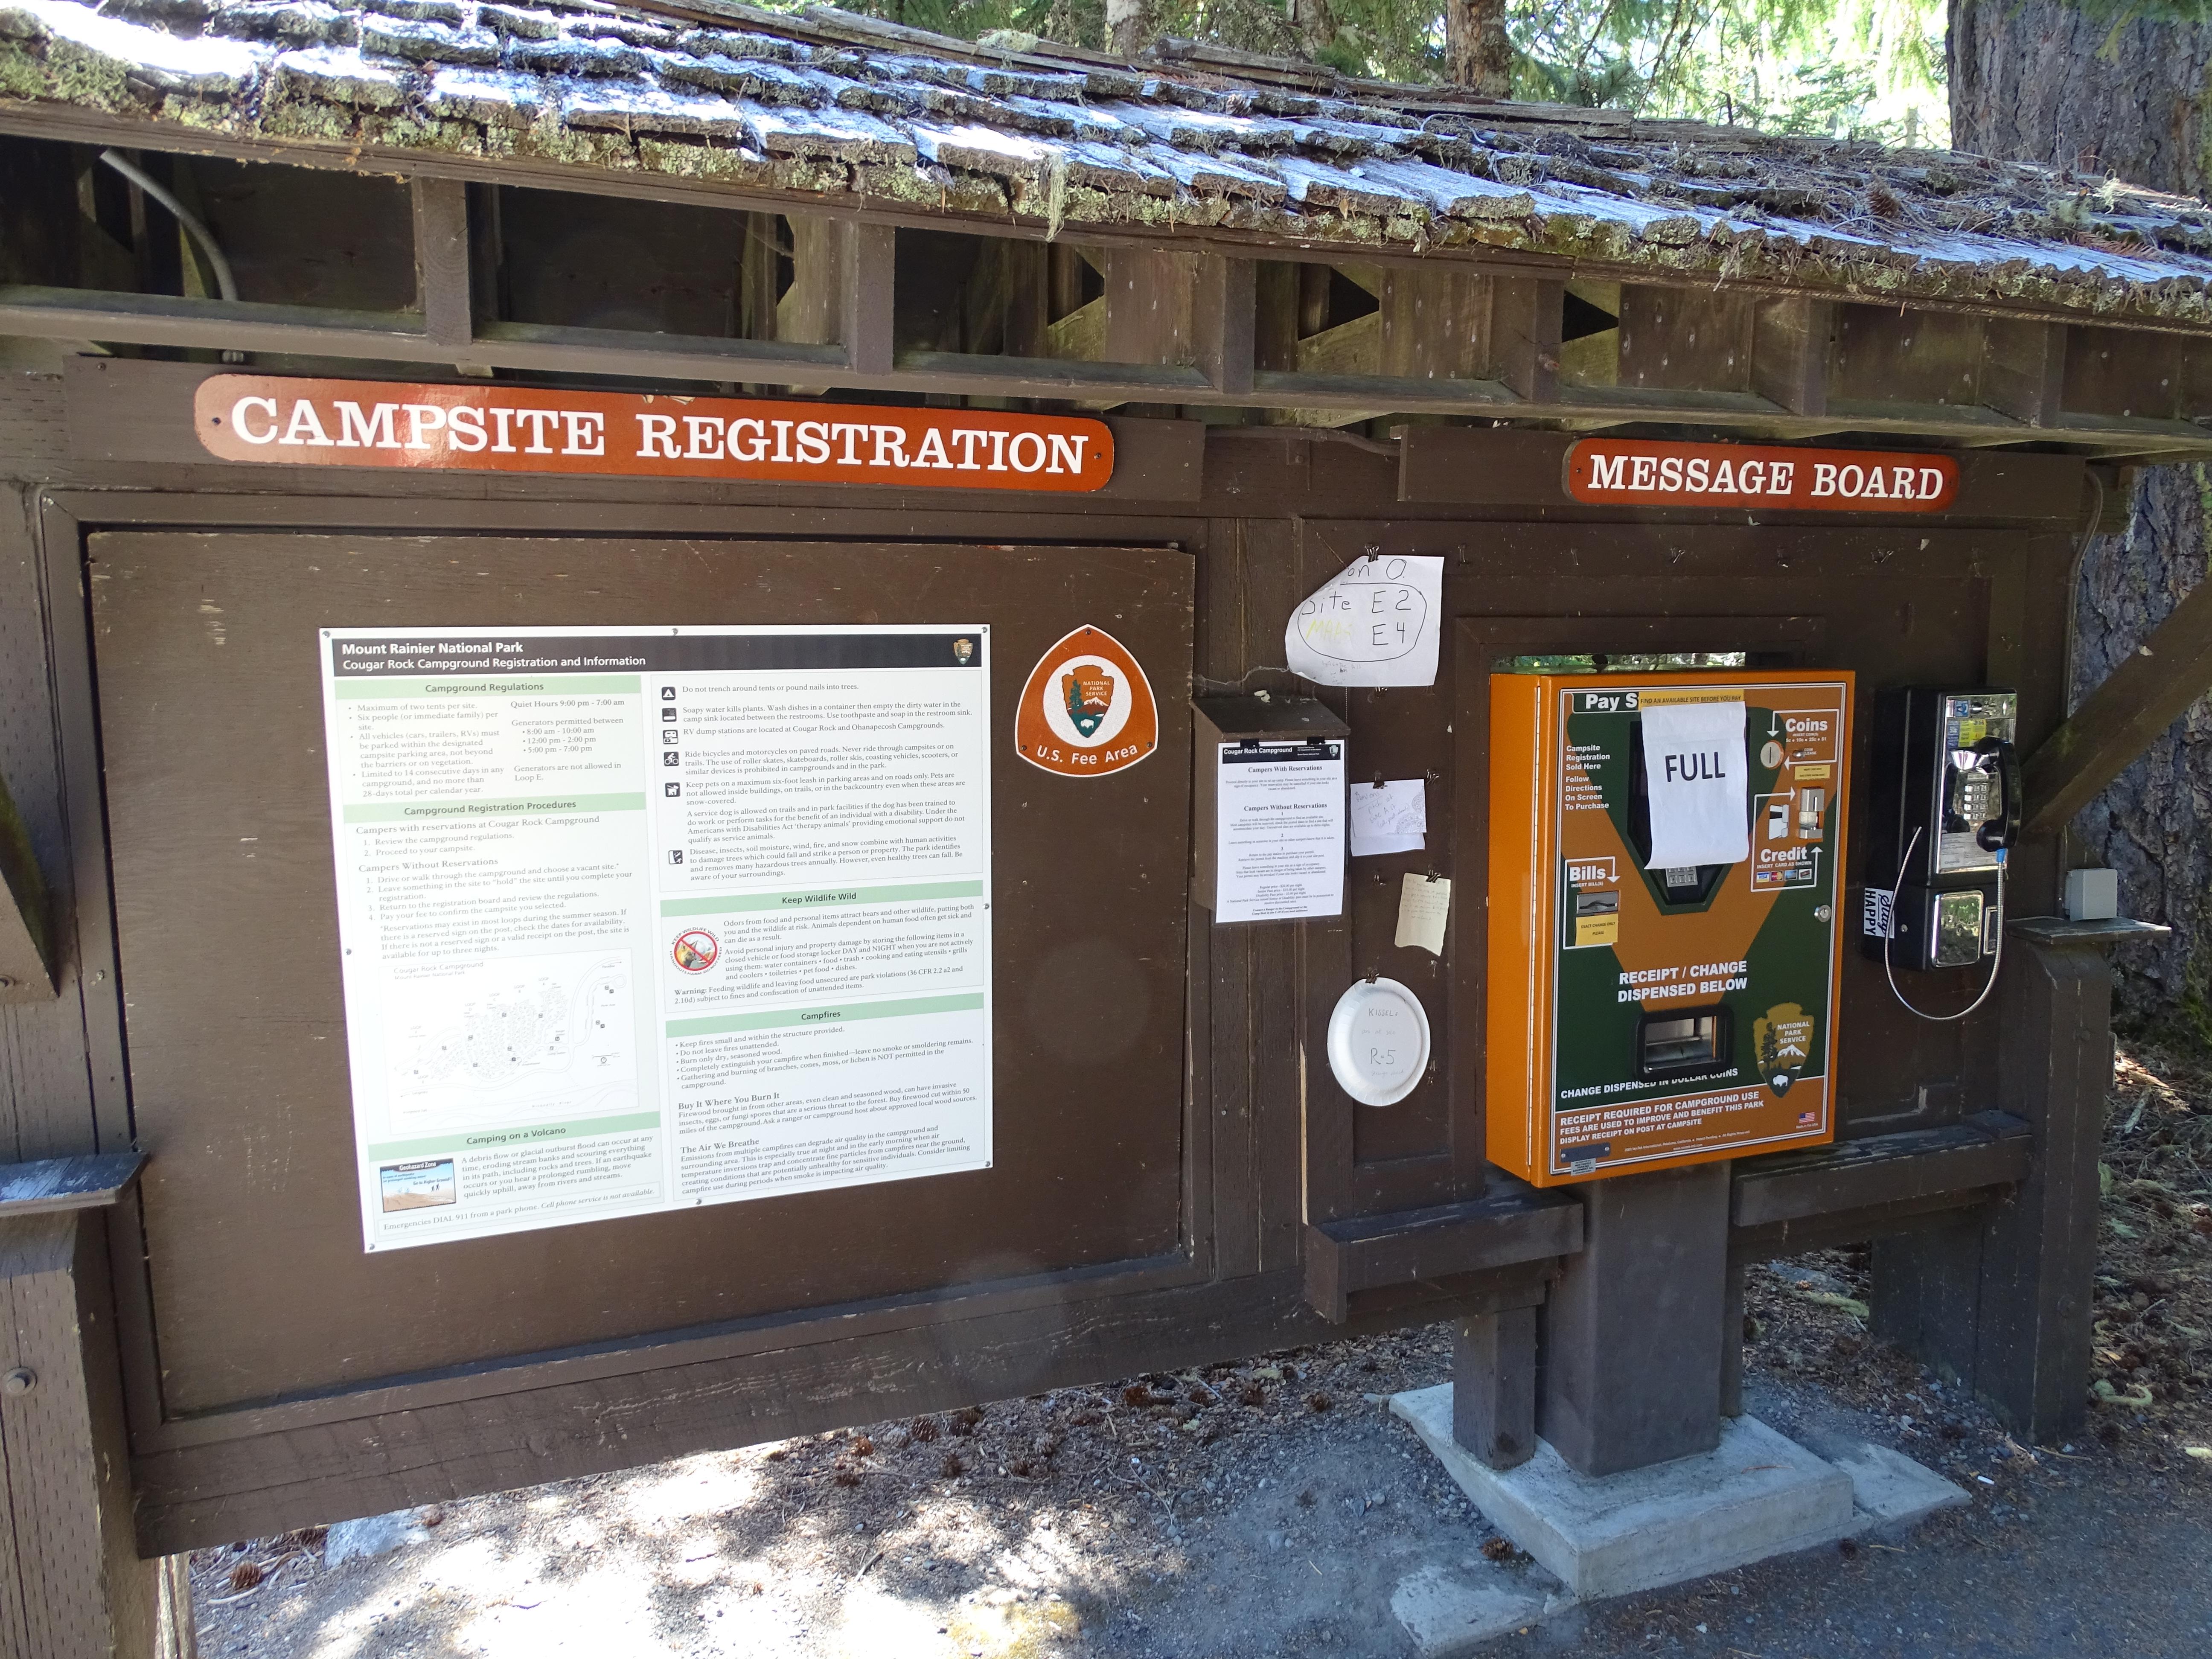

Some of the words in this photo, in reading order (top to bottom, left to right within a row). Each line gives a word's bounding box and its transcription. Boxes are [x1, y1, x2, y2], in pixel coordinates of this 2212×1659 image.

[231, 396, 605, 455] CAMPSITE
[635, 413, 1089, 474] REGISTRATION
[1587, 454, 1794, 495] MESSAGE
[1810, 463, 1943, 500] BOARD
[342, 643, 387, 655] Mount
[390, 643, 436, 654] Rainier
[438, 642, 492, 653] National
[495, 641, 524, 652] Park
[343, 660, 385, 672] Cougar
[387, 658, 415, 669] Rock
[417, 658, 489, 670] Campground
[492, 657, 558, 669] Registration
[560, 656, 581, 666] and
[583, 656, 646, 666] Information
[425, 683, 486, 694] Campground
[489, 682, 544, 693] Regulations
[786, 684, 808, 692] pound
[1586, 694, 1620, 711] Pay
[1785, 718, 1828, 732] Coins
[1037, 745, 1063, 763] U.S.
[1071, 752, 1097, 765] Fee
[1105, 744, 1138, 763] Area
[1566, 744, 1601, 753] Campsite
[1566, 753, 1610, 762] Registration
[1665, 751, 1725, 783] FULL
[404, 805, 465, 816] Campground
[468, 803, 524, 814] Registration
[527, 800, 576, 809] Procedures
[1760, 846, 1807, 862] Credit
[358, 864, 399, 873] Campers
[442, 858, 498, 867] Reservations
[1569, 865, 1606, 882] Bills
[804, 894, 836, 902] Wildlife
[838, 892, 856, 900] Wild
[1865, 890, 1876, 934] HAPPY
[1619, 967, 1679, 985] RECEIPT
[1682, 966, 1687, 978] /
[1690, 960, 1747, 977] CHANGE
[1618, 983, 1696, 1002] DISPENSED
[1700, 977, 1747, 993] BELOW
[801, 1011, 841, 1020] Campfires
[1777, 1021, 1810, 1030] NATIONAL
[1779, 1036, 1806, 1044] SERVICE
[1560, 1086, 1601, 1099] CHANGE
[1604, 1081, 1656, 1093] DISPENSED
[1560, 1112, 1601, 1126] RECEIPT
[1604, 1106, 1652, 1120] REQUIRED
[1654, 1103, 1673, 1113] FOR
[1675, 1094, 1739, 1110] CAMPGROUND
[1741, 1091, 1759, 1100] USE
[1560, 1126, 1580, 1135] FEES
[1582, 1123, 1598, 1132] ARE
[1601, 1120, 1622, 1129] USED
[1623, 1118, 1634, 1126] TO
[1636, 1113, 1671, 1124] IMPROVE
[1672, 1111, 1689, 1119] AND
[1691, 1106, 1723, 1117] BENEFIT
[1724, 1103, 1742, 1112] THIS
[1744, 1100, 1764, 1109] PARK
[466, 1134, 506, 1144] Camping
[531, 1128, 566, 1137] Volcano
[1560, 1134, 1590, 1144] DISPLAY
[1592, 1129, 1622, 1140] RECEIPT
[1636, 1124, 1655, 1133] POST
[1667, 1118, 1702, 1129] CAMPSITE
[728, 1138, 759, 1148] Breathe
